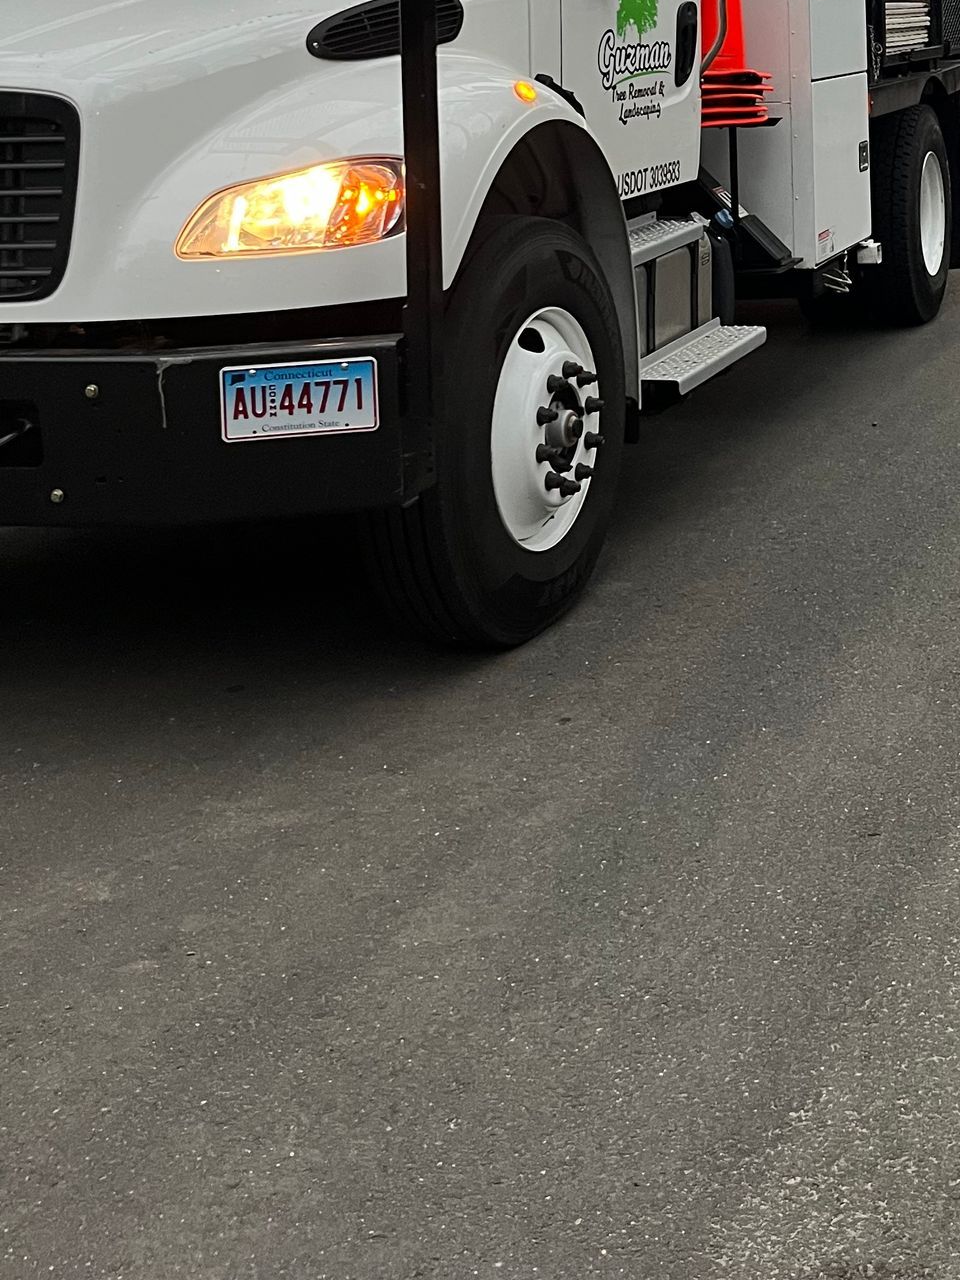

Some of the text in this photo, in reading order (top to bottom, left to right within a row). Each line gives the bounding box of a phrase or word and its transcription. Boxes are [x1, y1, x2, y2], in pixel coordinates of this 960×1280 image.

[598, 28, 671, 90] Guzman
[611, 84, 627, 103] Tree
[628, 81, 658, 100] Removal
[618, 100, 661, 126] Landscaping
[617, 168, 648, 197] USDOT
[264, 369, 333, 382] Connecticut
[261, 420, 340, 433] Constitution State
